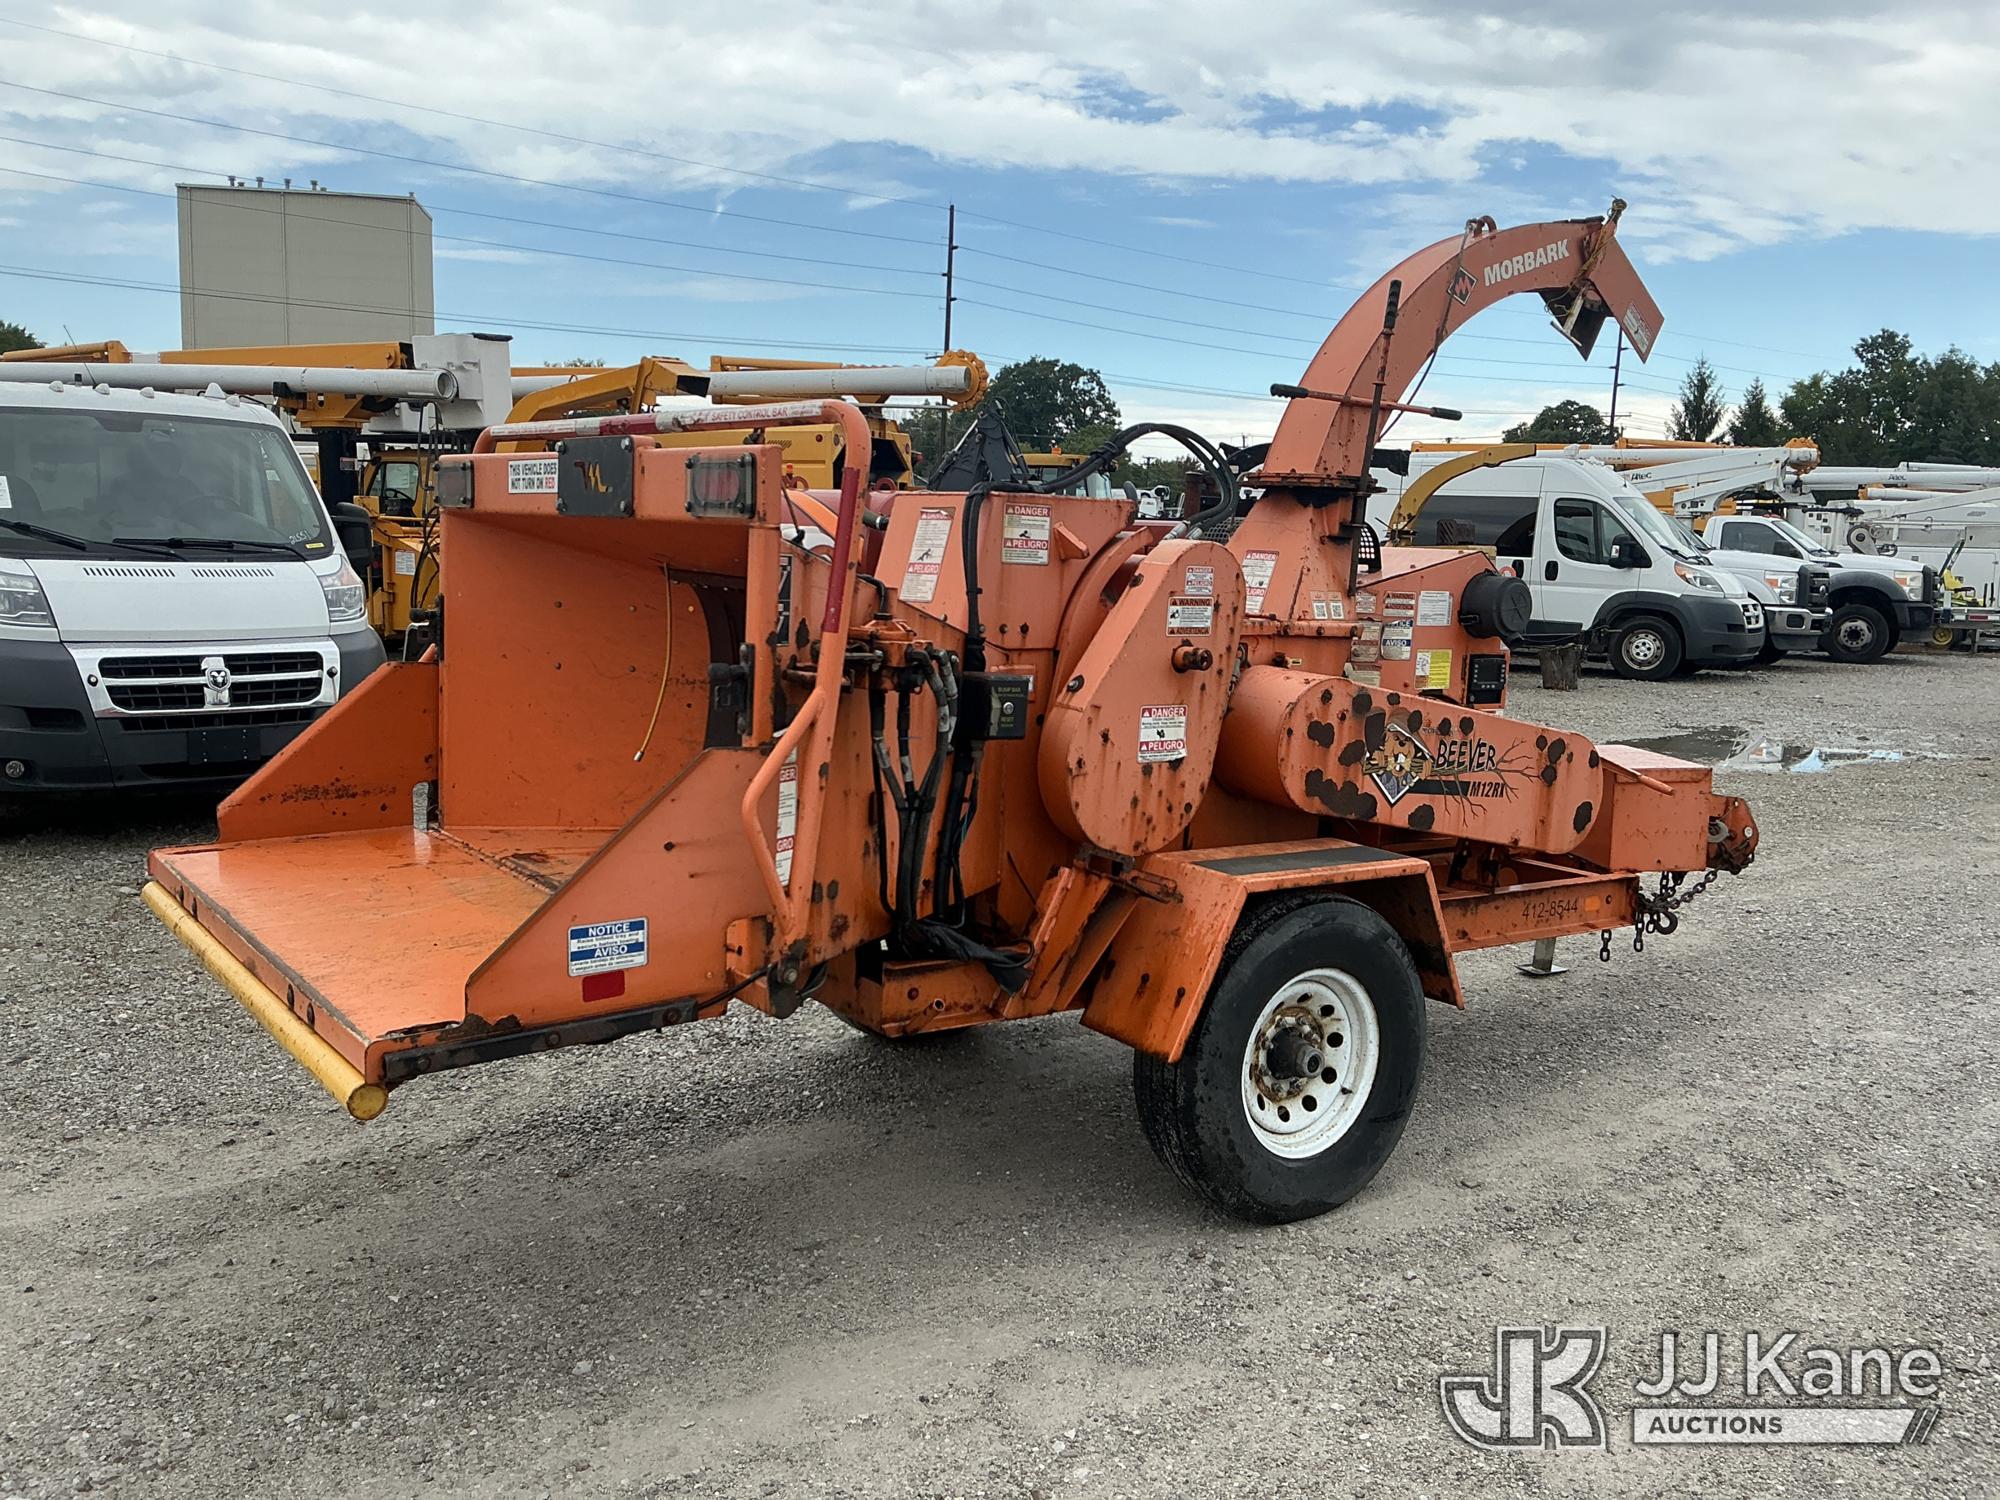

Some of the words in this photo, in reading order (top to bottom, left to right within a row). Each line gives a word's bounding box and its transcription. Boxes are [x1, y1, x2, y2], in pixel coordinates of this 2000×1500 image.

[1483, 238, 1570, 288] MORBARK
[711, 411, 737, 423] SAFETY
[738, 406, 772, 419] CONTROL
[773, 406, 789, 417] BAR
[510, 464, 520, 476] THIS
[521, 462, 542, 475] VEHICLE
[543, 462, 557, 475] DOES
[511, 479, 521, 489] NOT
[521, 478, 535, 489] TURN
[536, 478, 544, 489] ON
[544, 477, 556, 488] RED
[1014, 506, 1049, 516] DANGER
[1012, 540, 1049, 550] PELIGRO
[913, 563, 939, 574] PELIGRO
[1385, 639, 1407, 647] AVISO
[1151, 707, 1185, 718] DANGER
[1148, 740, 1184, 751] PELIGRO
[1436, 738, 1497, 772] BEEVER
[1522, 898, 1578, 920] 412-8544
[588, 922, 631, 937] NOTICE
[594, 945, 628, 958] AVISO
